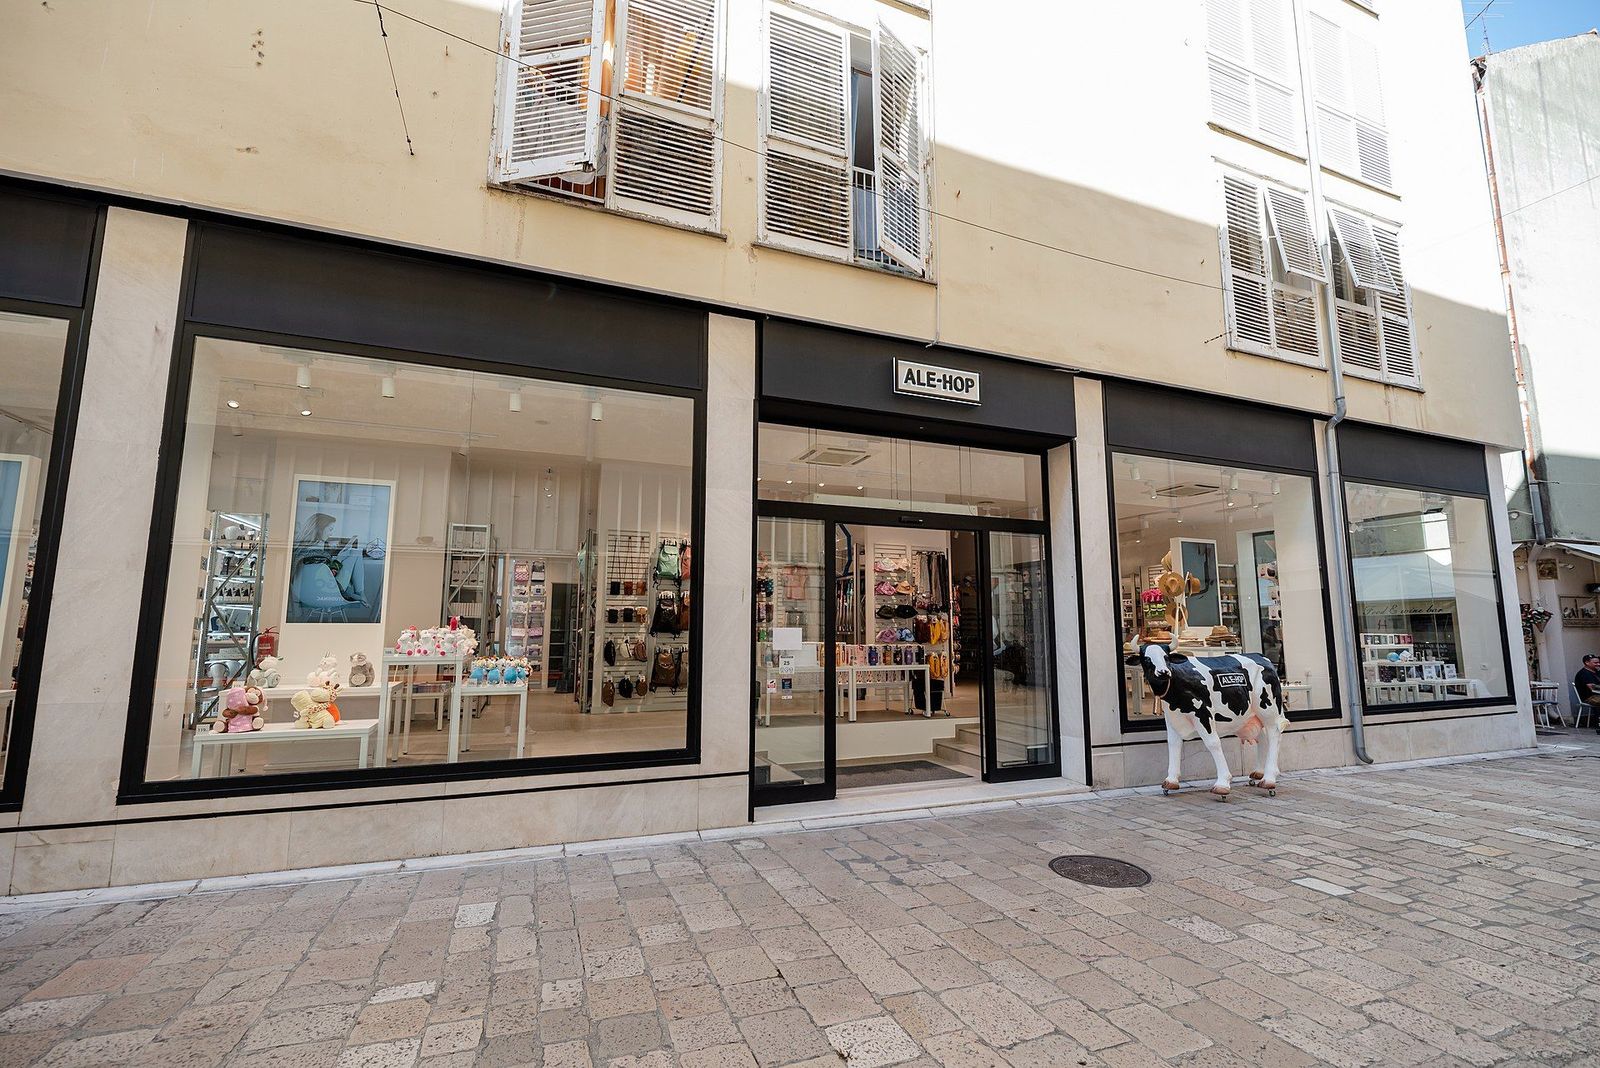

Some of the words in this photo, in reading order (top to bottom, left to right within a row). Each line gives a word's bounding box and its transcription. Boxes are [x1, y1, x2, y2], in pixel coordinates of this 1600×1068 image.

[904, 368, 974, 393] ALE-HOP
[1426, 605, 1443, 613] bar
[1222, 676, 1244, 684] ALE-HOP
